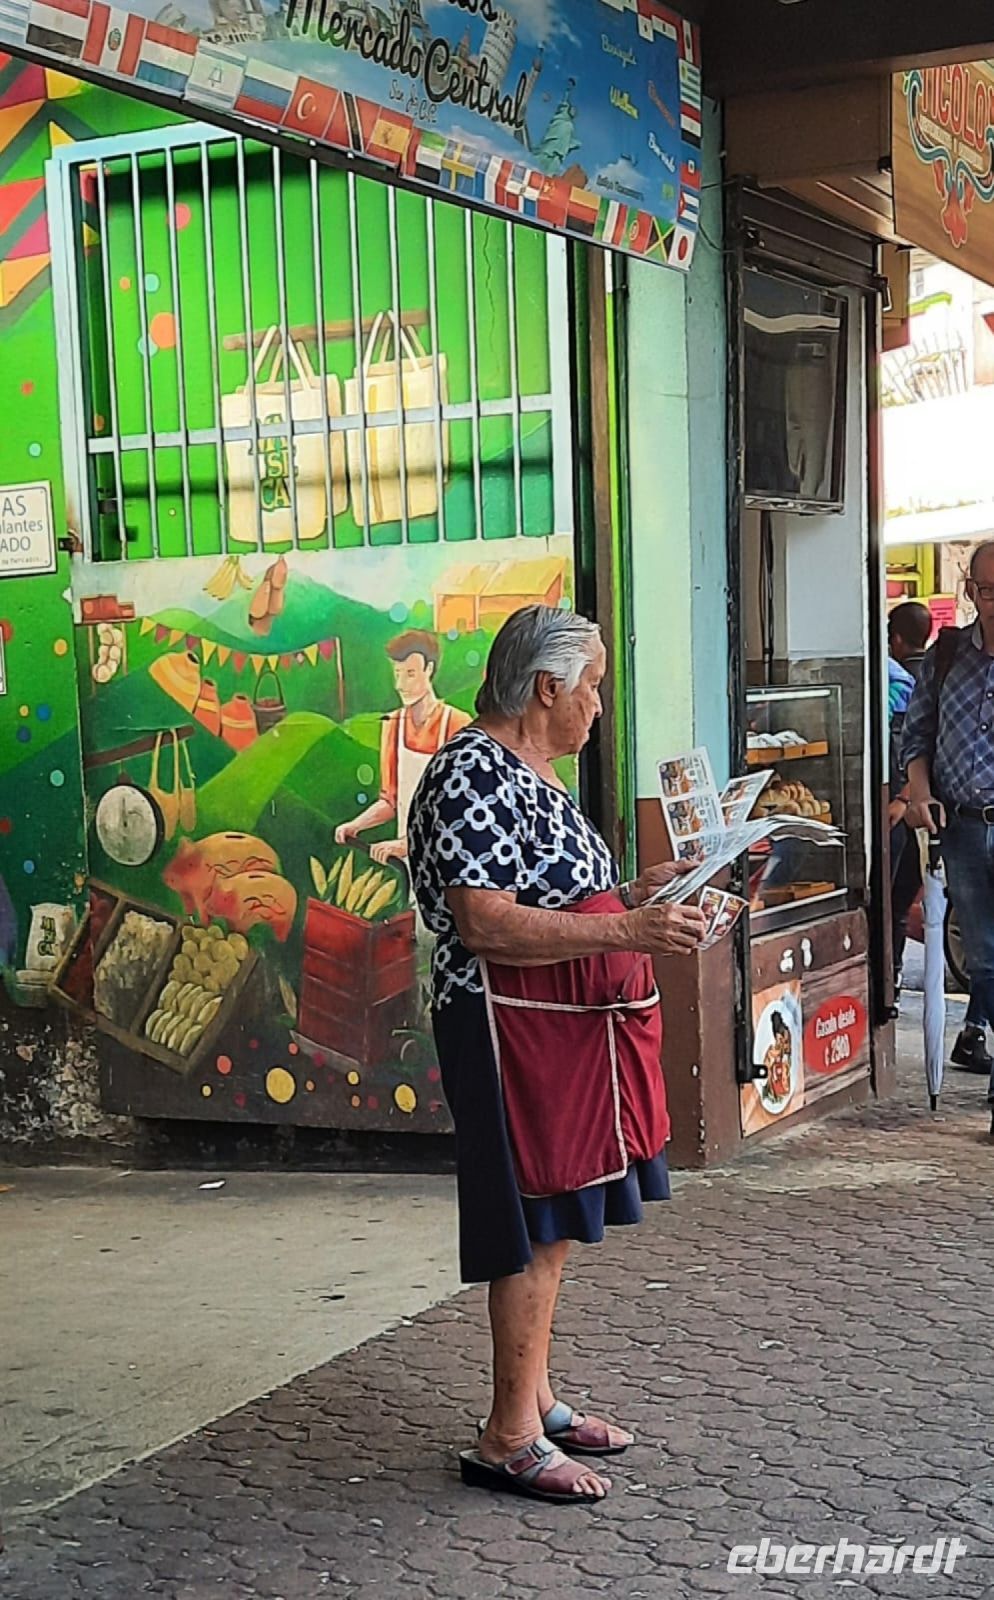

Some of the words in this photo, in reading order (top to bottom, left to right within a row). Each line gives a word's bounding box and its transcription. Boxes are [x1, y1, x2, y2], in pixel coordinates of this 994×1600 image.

[424, 38, 526, 128] Central
[2, 495, 26, 517] AS
[0, 519, 43, 534] lantes
